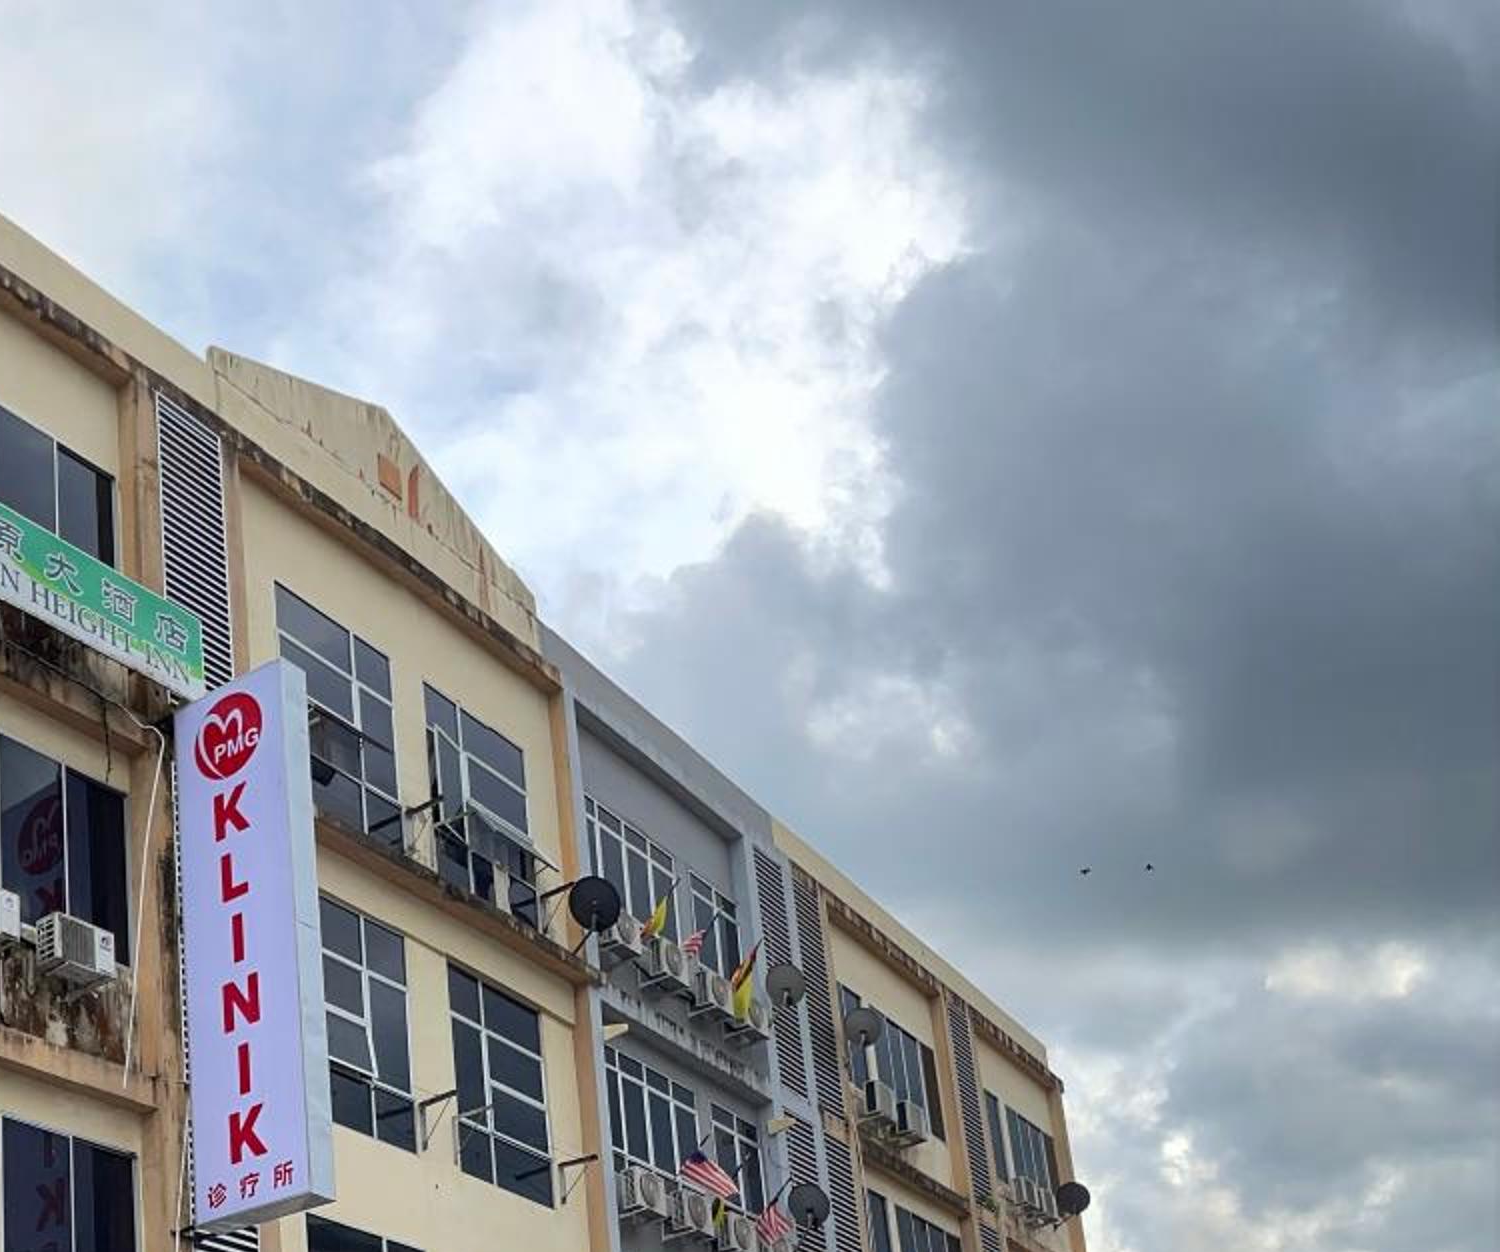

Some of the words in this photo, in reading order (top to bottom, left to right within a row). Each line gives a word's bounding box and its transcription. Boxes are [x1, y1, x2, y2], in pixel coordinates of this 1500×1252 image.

[30, 580, 133, 652] HEIGHT
[144, 648, 191, 685] INN
[214, 728, 259, 764] PMG
[213, 781, 267, 1165] KLINIK
[207, 1160, 294, 1209] 诊疗所
